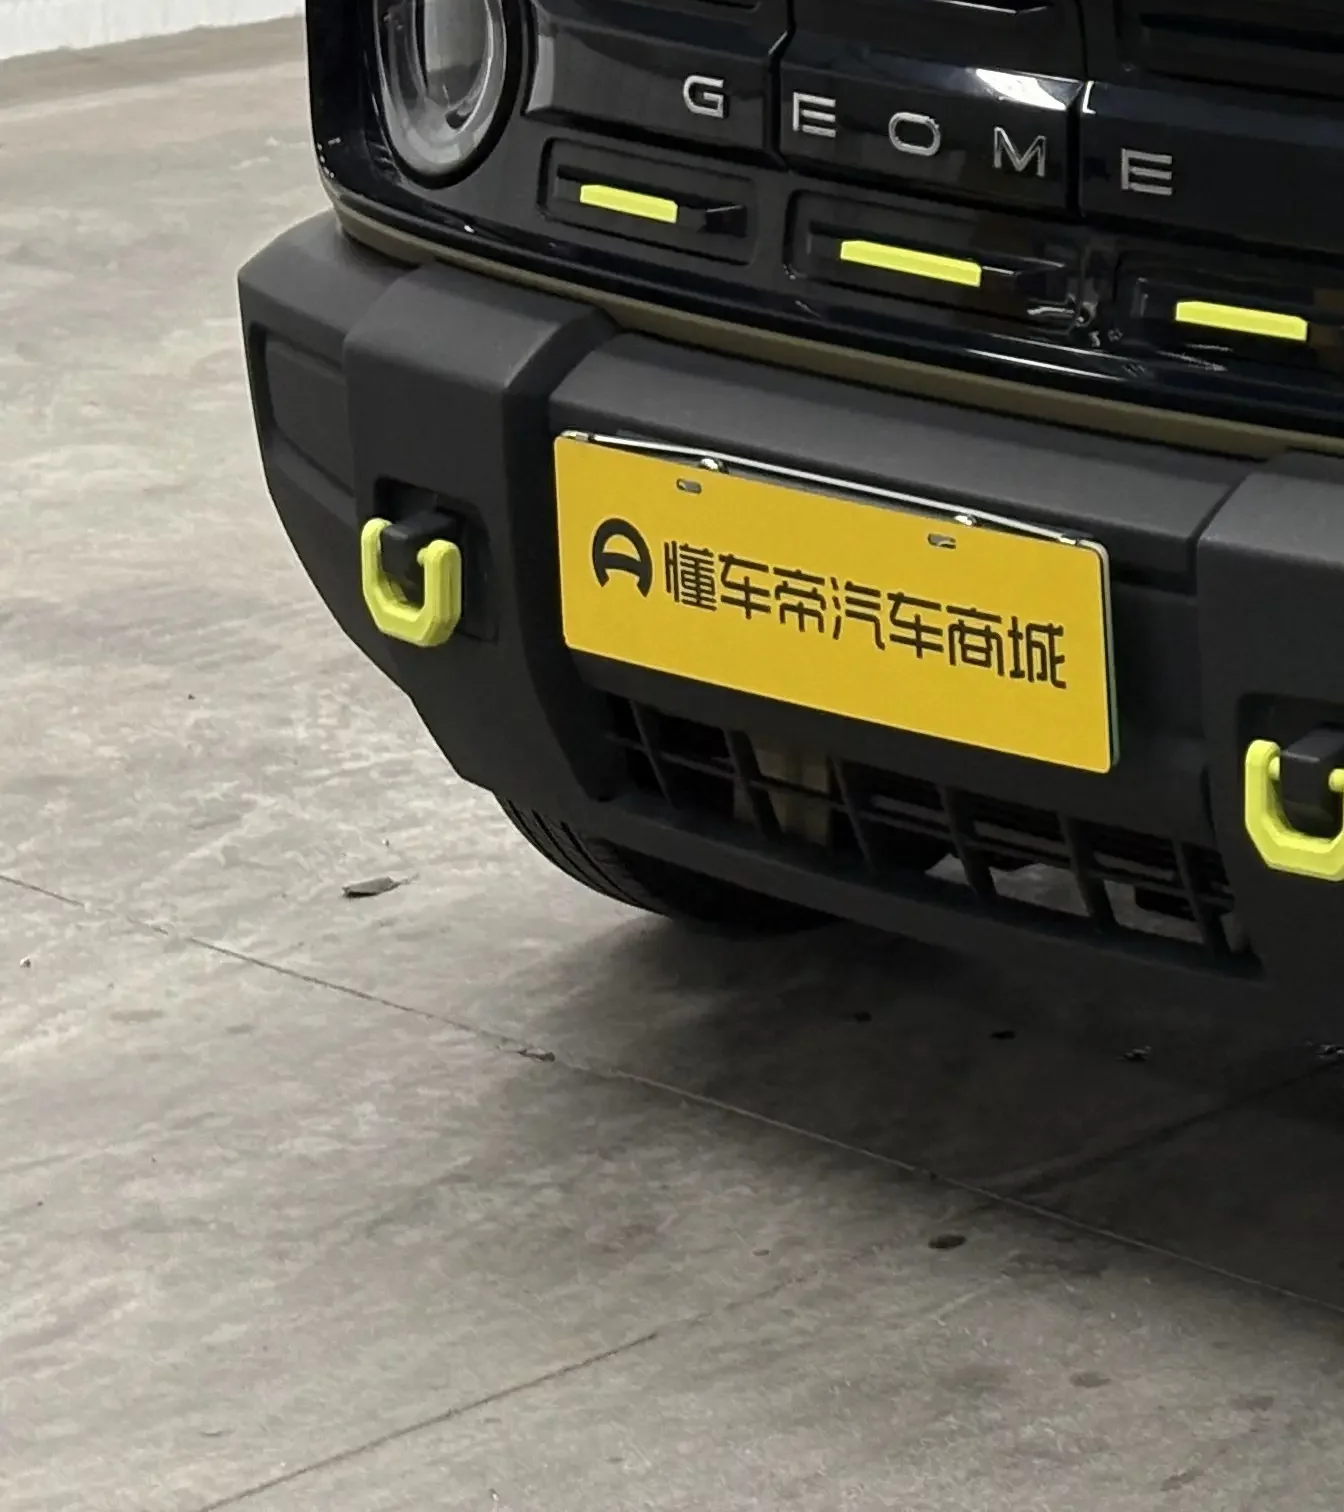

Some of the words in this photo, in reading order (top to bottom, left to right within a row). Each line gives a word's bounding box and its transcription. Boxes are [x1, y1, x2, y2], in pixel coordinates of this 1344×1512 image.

[682, 73, 1173, 196] GEOME
[663, 539, 1068, 690] 懂车帝汽车商城
